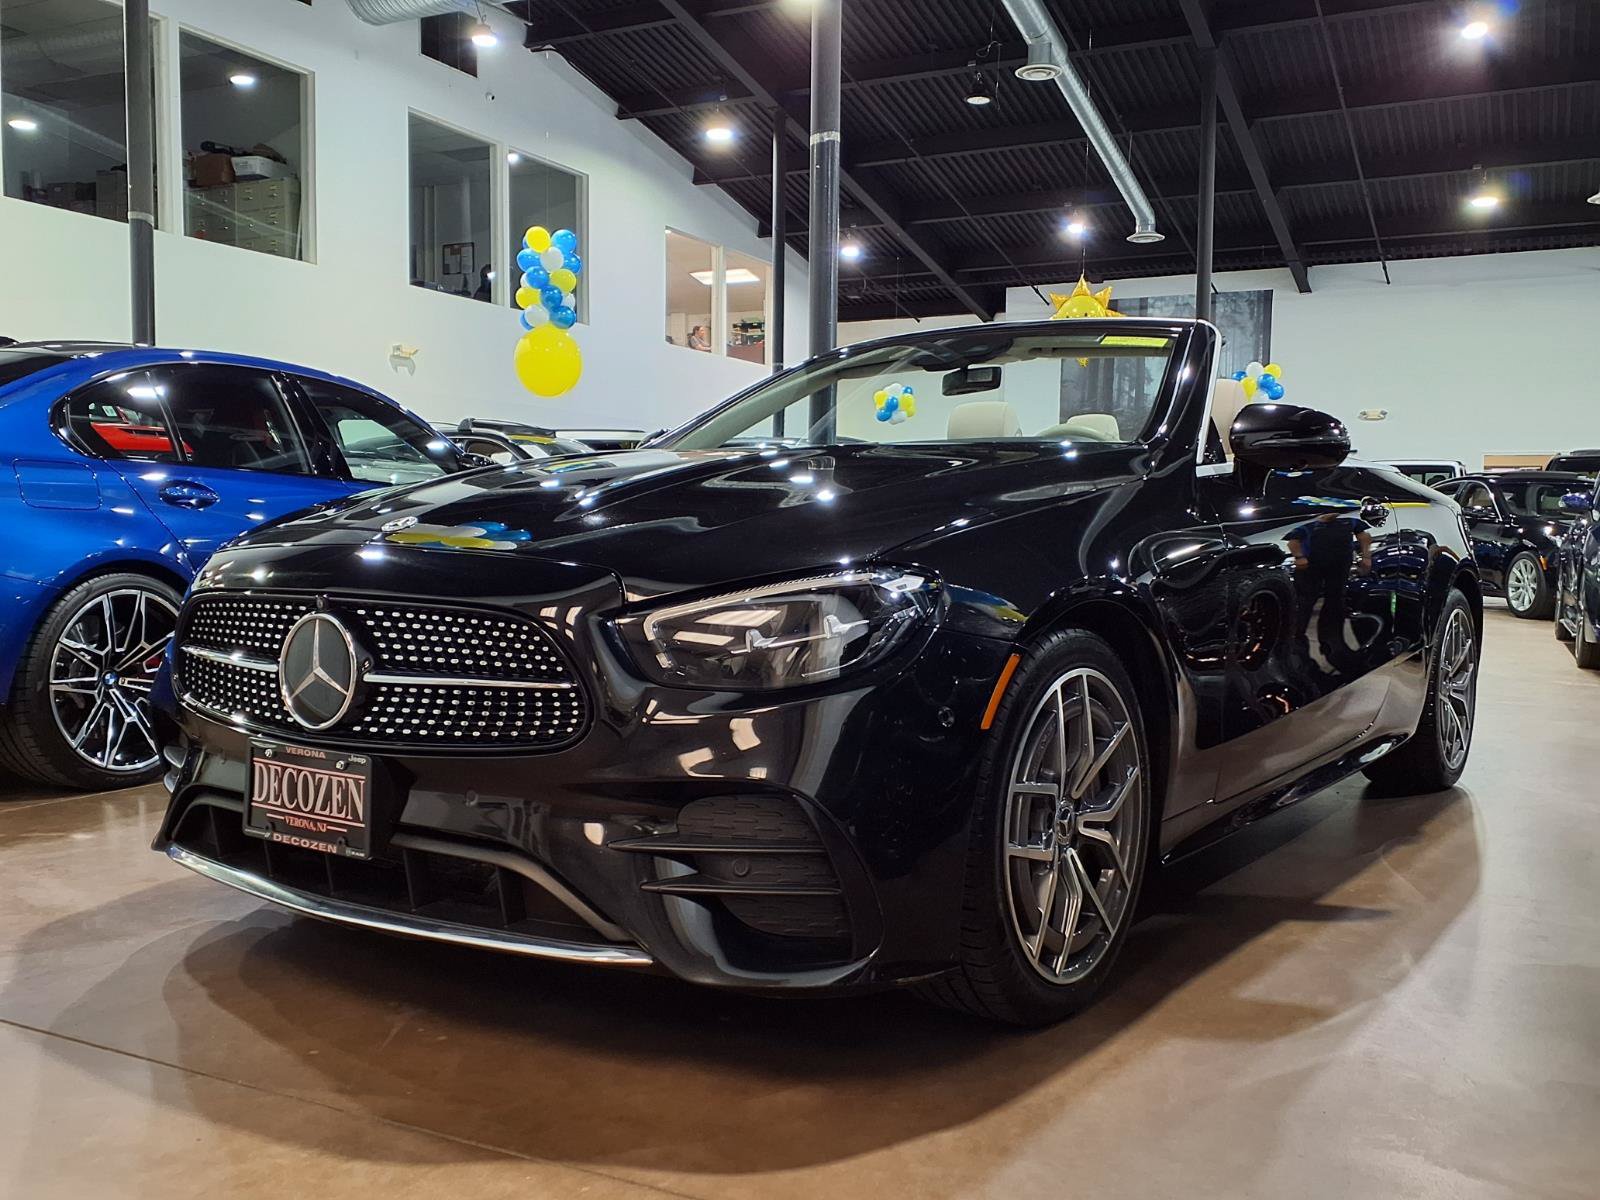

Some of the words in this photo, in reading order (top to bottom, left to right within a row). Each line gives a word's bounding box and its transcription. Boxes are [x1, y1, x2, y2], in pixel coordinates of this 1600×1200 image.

[285, 747, 326, 759] VERONA
[252, 762, 366, 822] DECOZEN
[285, 816, 317, 832] VERONA,
[317, 823, 328, 832] NJ
[272, 832, 337, 854] DECOZEN
